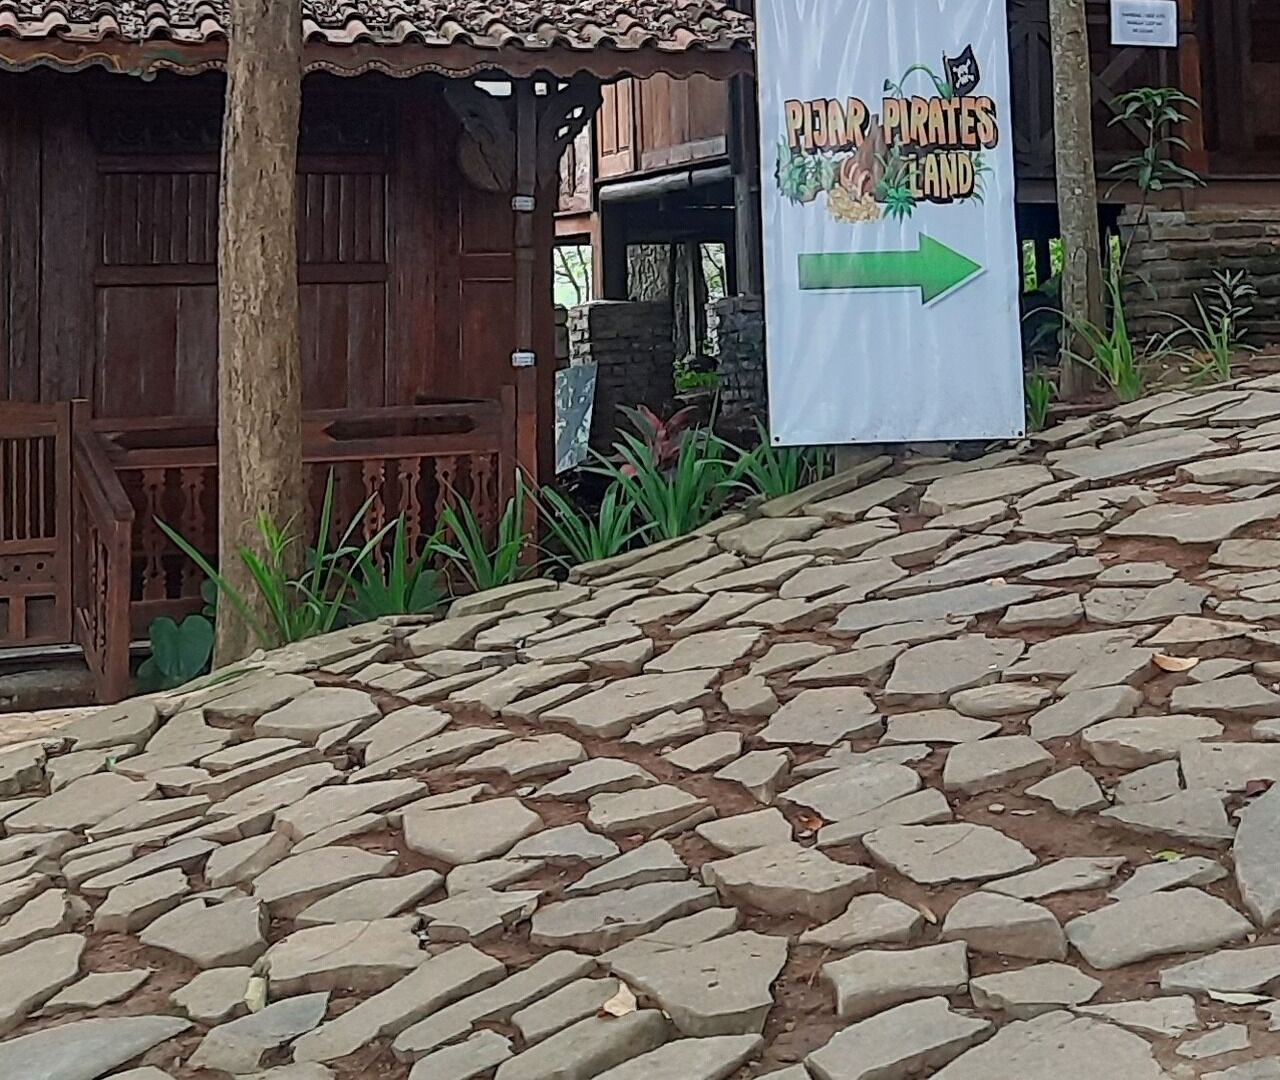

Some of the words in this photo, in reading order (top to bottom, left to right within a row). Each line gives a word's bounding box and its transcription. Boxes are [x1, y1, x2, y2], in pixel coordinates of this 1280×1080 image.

[784, 97, 868, 150] PIJAR
[883, 96, 997, 147] PIRATES
[907, 152, 975, 199] LAND
